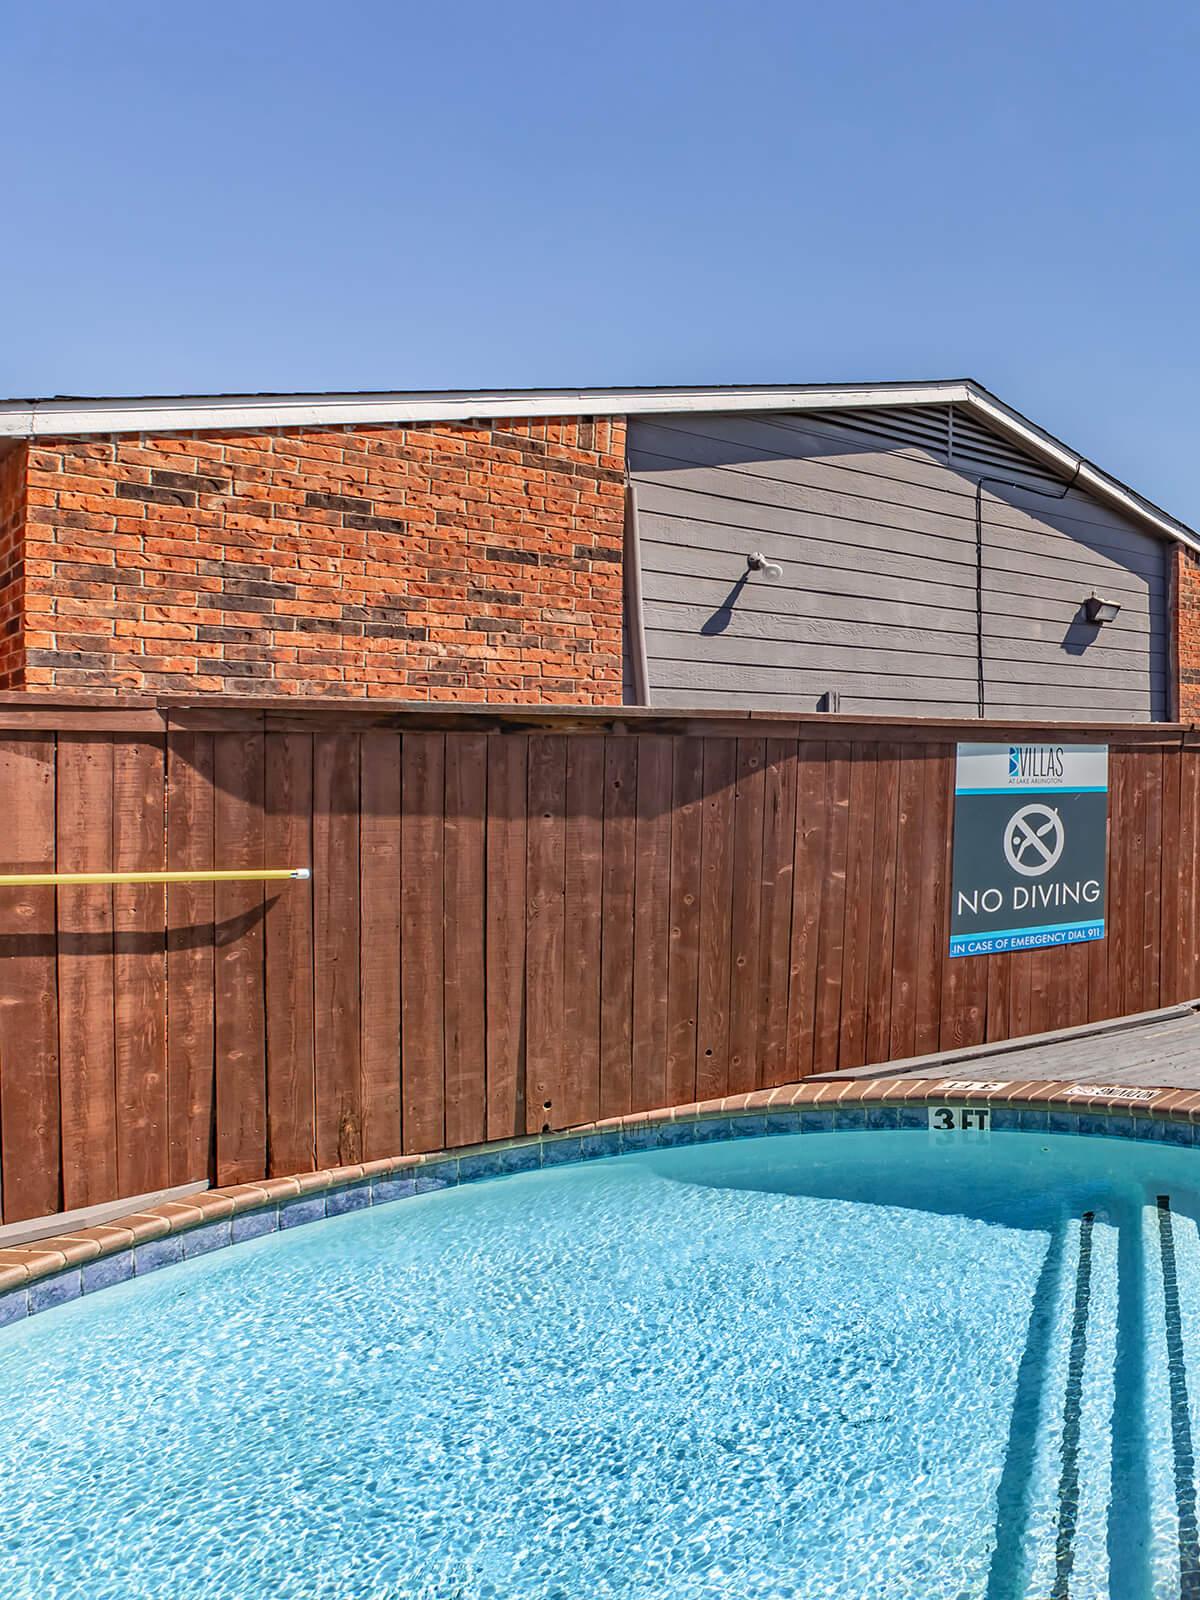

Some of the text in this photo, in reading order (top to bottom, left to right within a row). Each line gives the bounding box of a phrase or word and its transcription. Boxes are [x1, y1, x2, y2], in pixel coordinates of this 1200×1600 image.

[1019, 747, 1064, 777] VILLAS
[957, 880, 1100, 916] NO DIVING
[953, 927, 1100, 954] IN CASE OF EMERGENCY DIAL 911
[933, 1108, 955, 1130] 3
